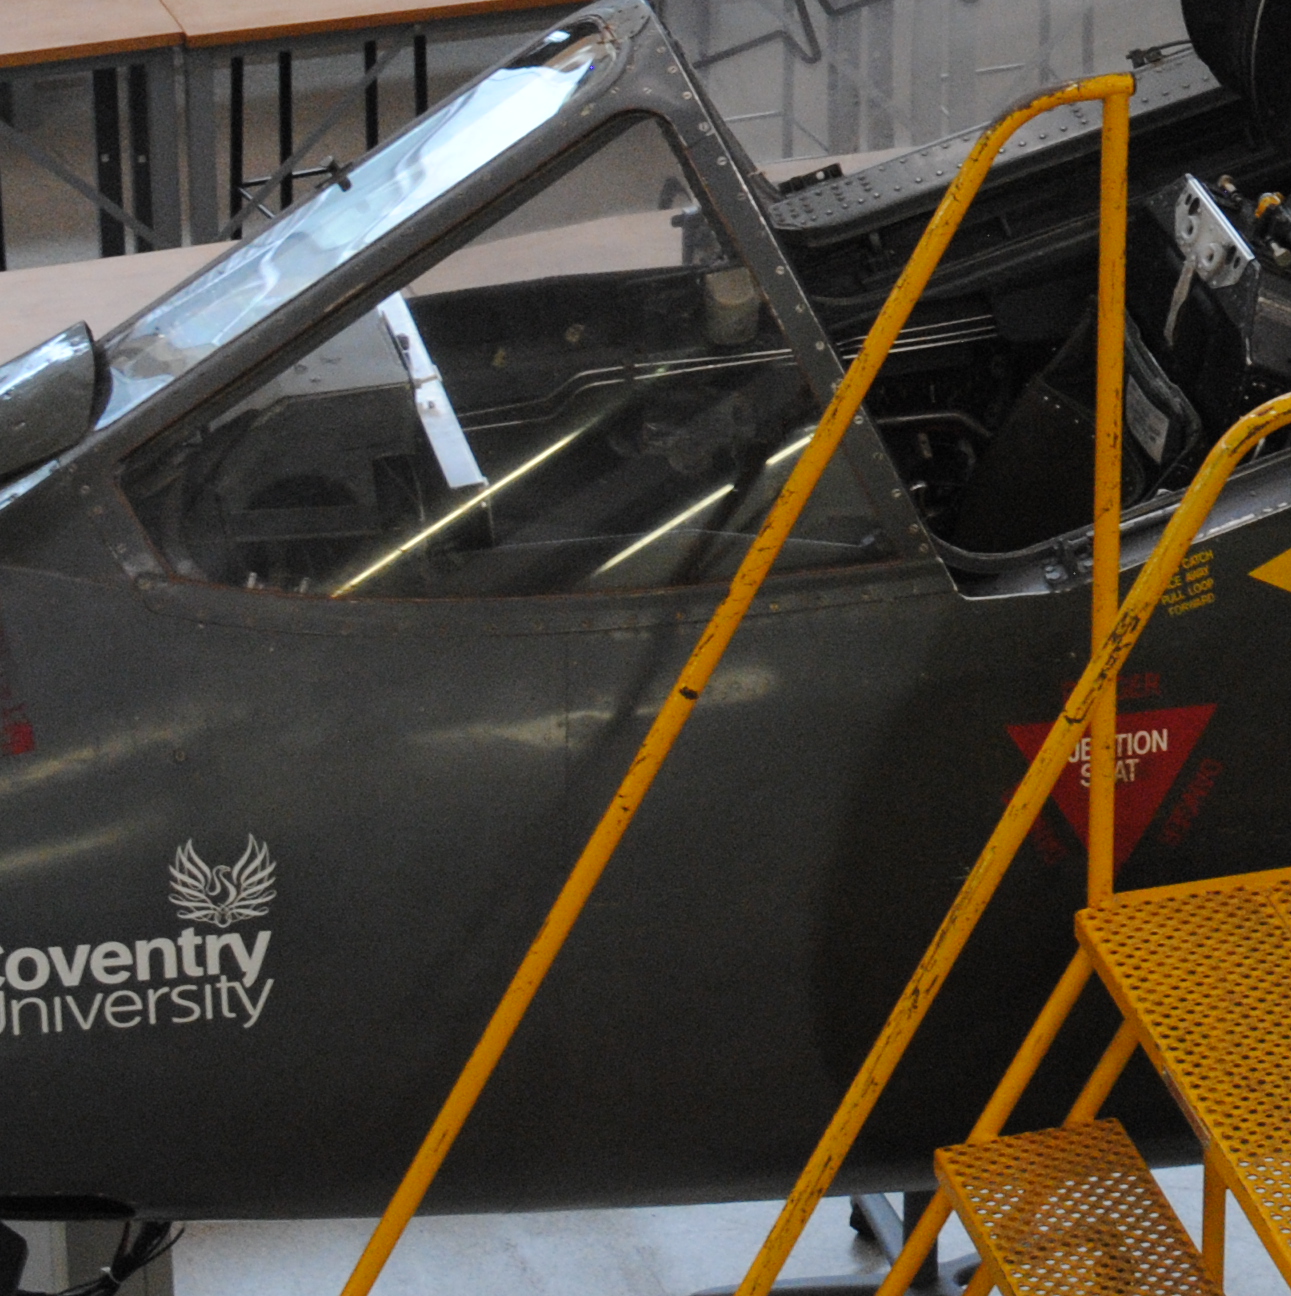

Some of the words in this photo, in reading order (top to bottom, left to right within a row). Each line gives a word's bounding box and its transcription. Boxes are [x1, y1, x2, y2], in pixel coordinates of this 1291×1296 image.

[1181, 549, 1215, 569] CATCH
[1161, 589, 1186, 606] PULL
[1188, 577, 1215, 596] LOOP
[1168, 592, 1216, 618] FORWARD
[1068, 728, 1168, 763] JETION
[1080, 758, 1140, 788] SAT
[0, 927, 272, 992] oventry
[0, 974, 275, 1036] niversity
